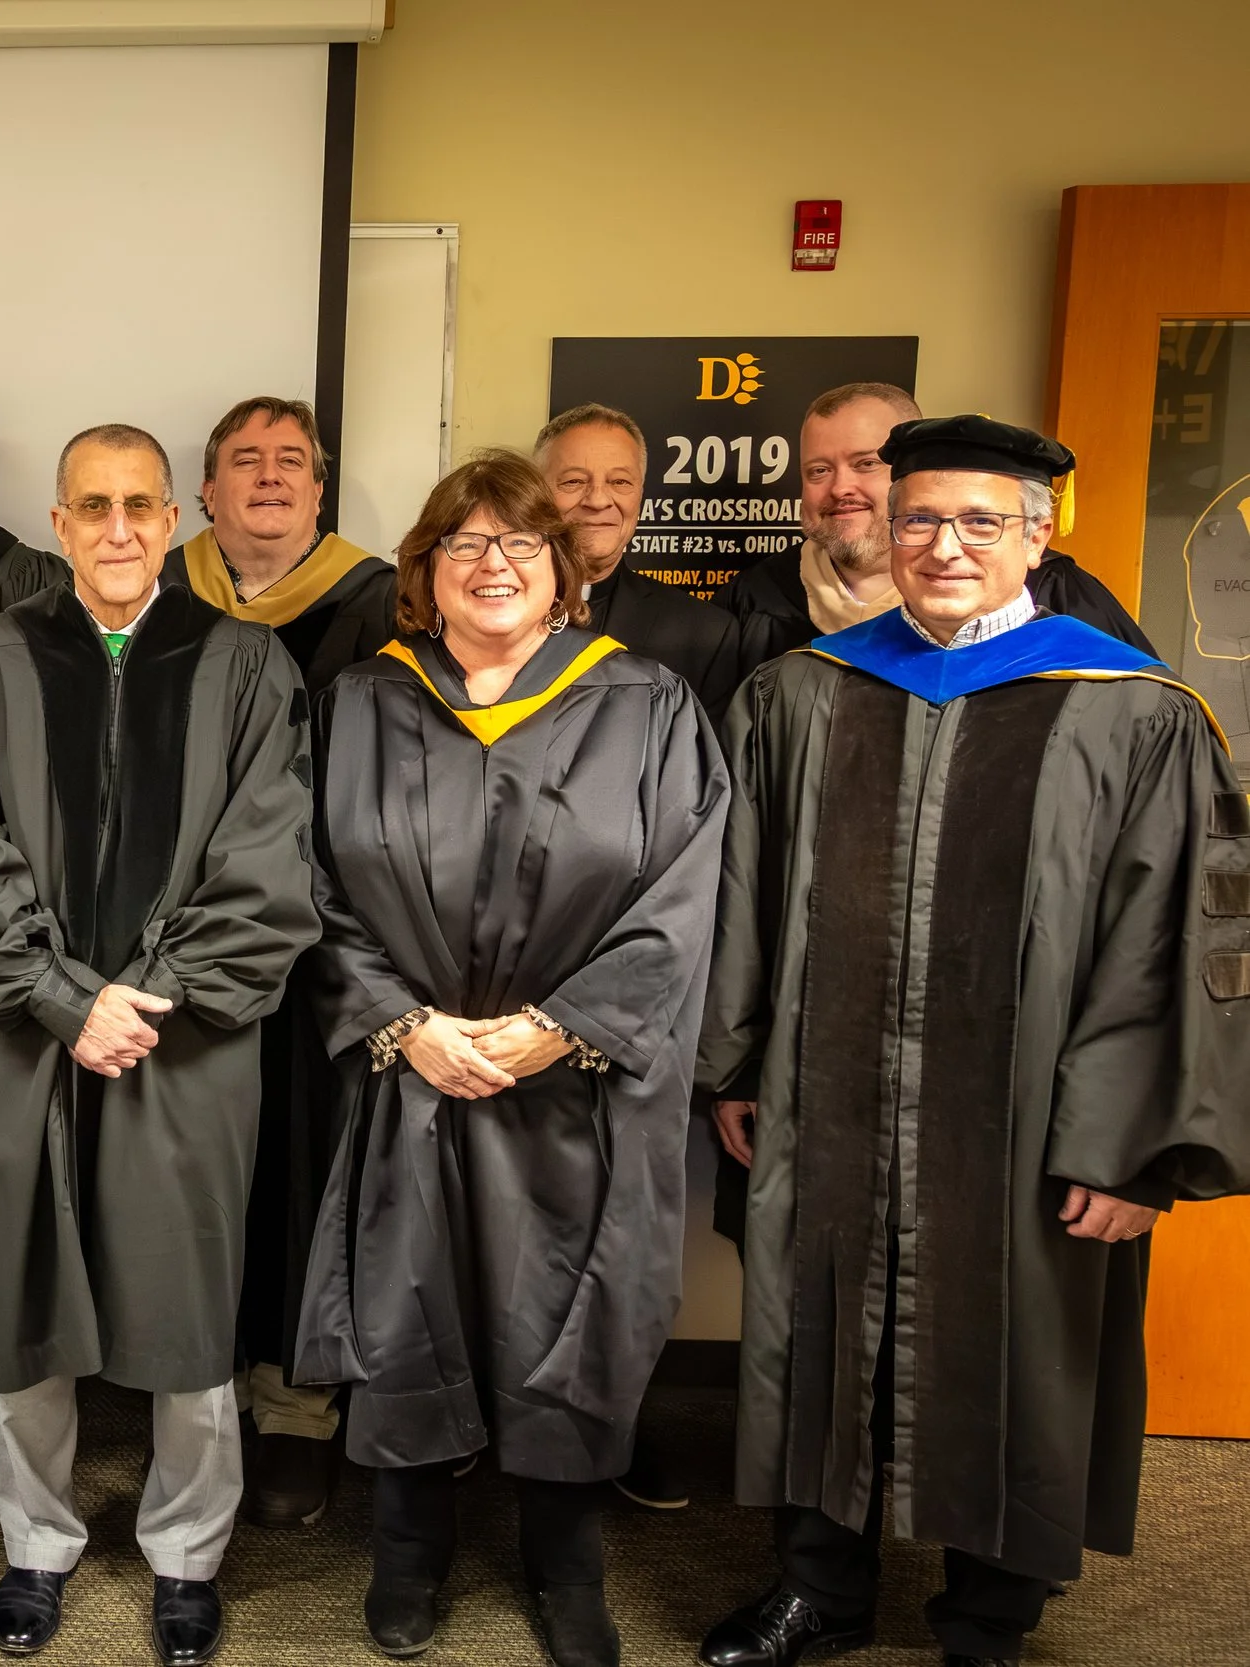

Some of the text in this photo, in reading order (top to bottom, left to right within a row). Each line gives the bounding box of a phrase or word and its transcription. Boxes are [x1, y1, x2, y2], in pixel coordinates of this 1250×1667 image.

[803, 233, 836, 244] FIRE
[662, 435, 790, 484] 2019
[637, 498, 674, 521] A'S
[630, 535, 679, 553] STATE
[682, 536, 713, 553] #23
[717, 540, 741, 553] vs.
[744, 535, 788, 553] OHIO
[1214, 579, 1250, 592] EVAC
